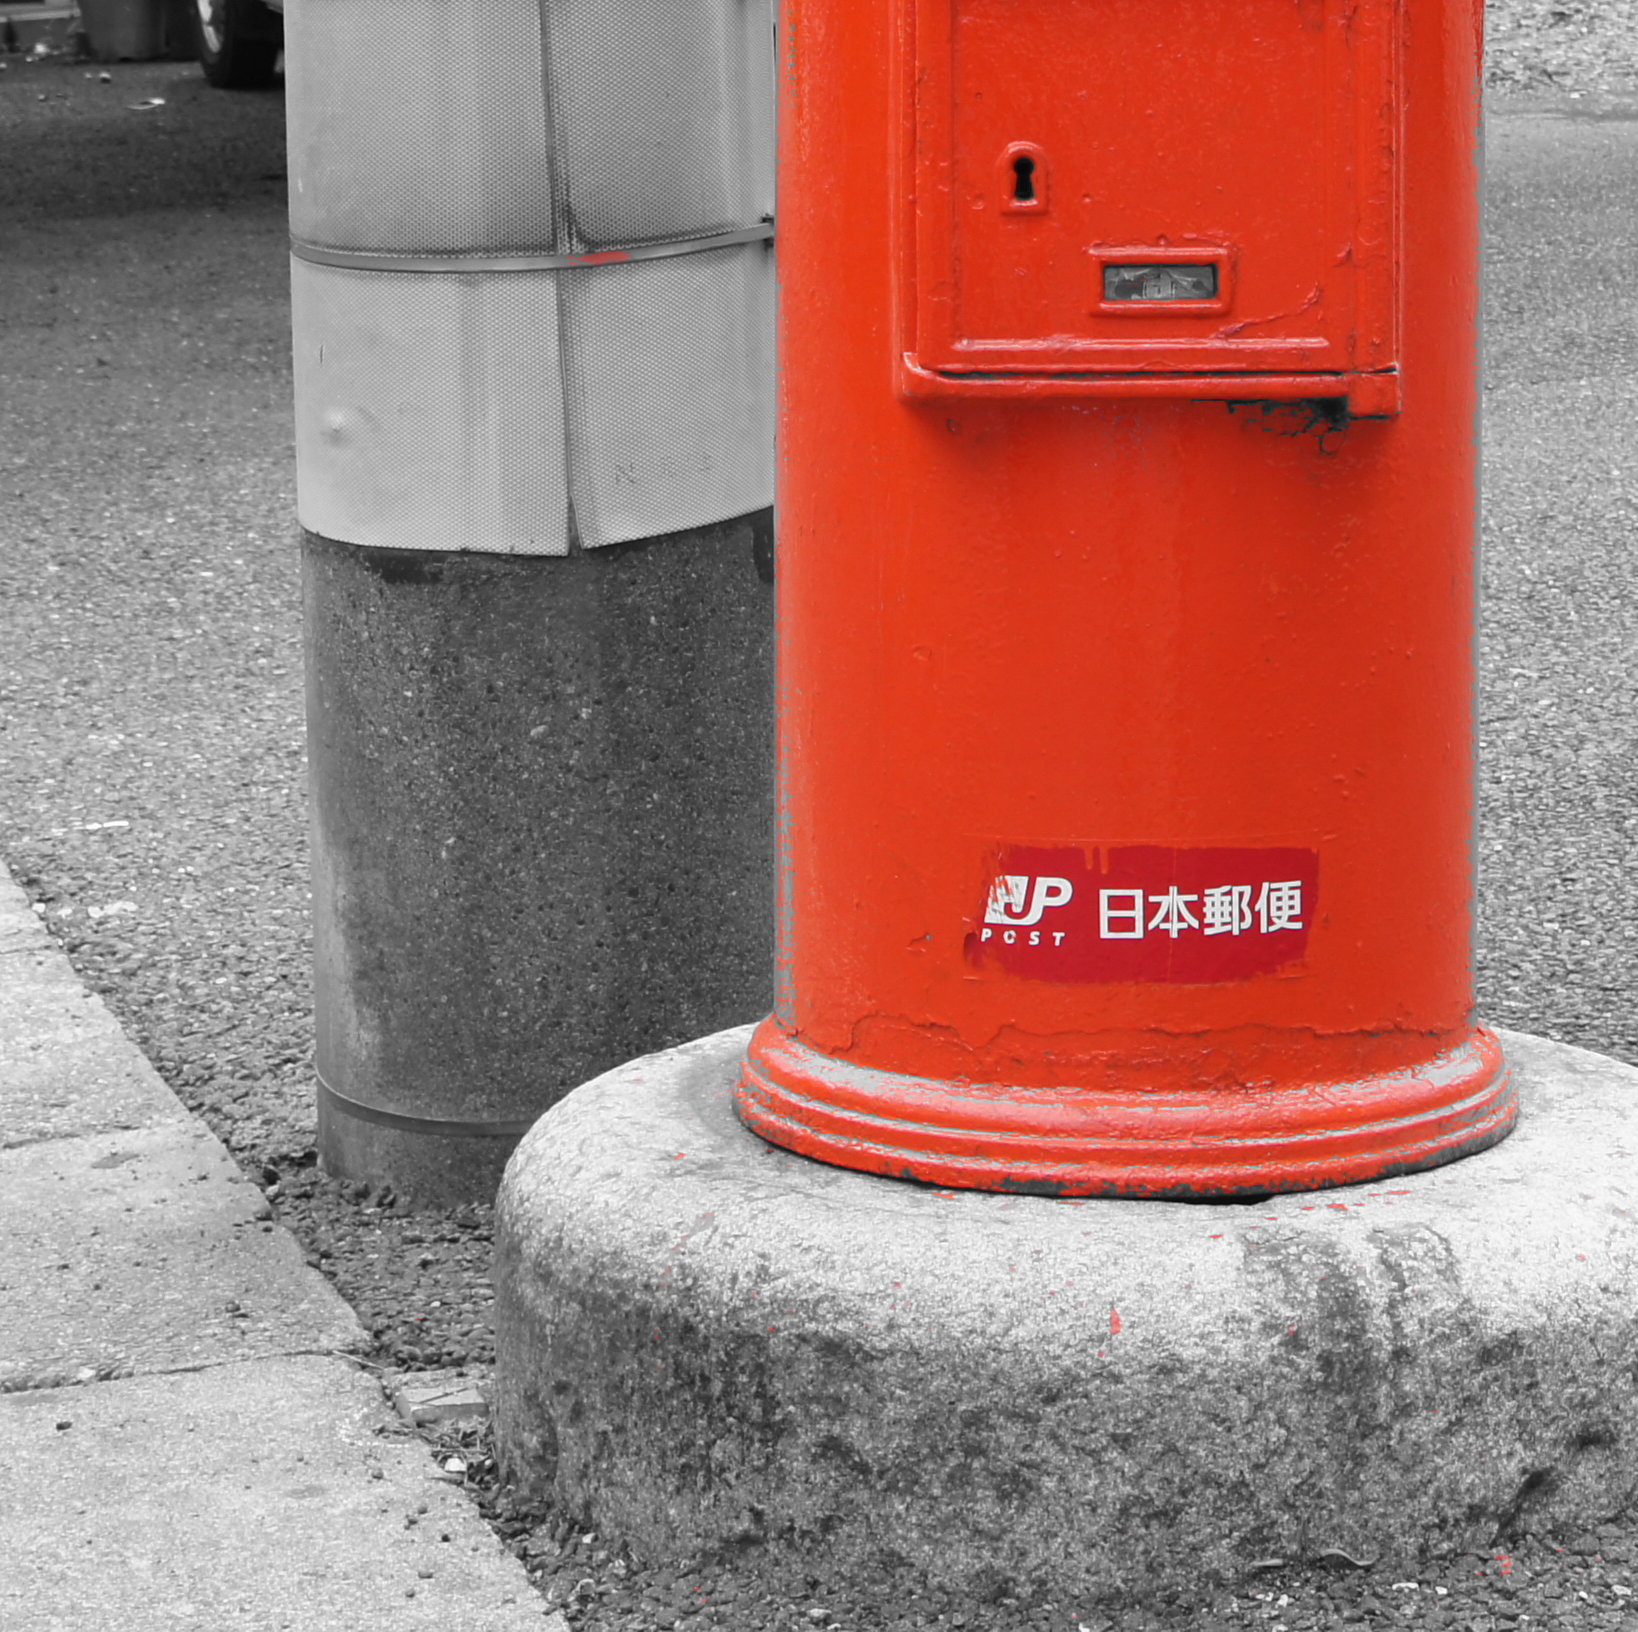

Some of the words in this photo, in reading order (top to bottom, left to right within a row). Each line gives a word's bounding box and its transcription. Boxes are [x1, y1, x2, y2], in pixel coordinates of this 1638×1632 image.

[1098, 879, 1304, 941] 日本郵便
[980, 927, 1066, 947] POST
